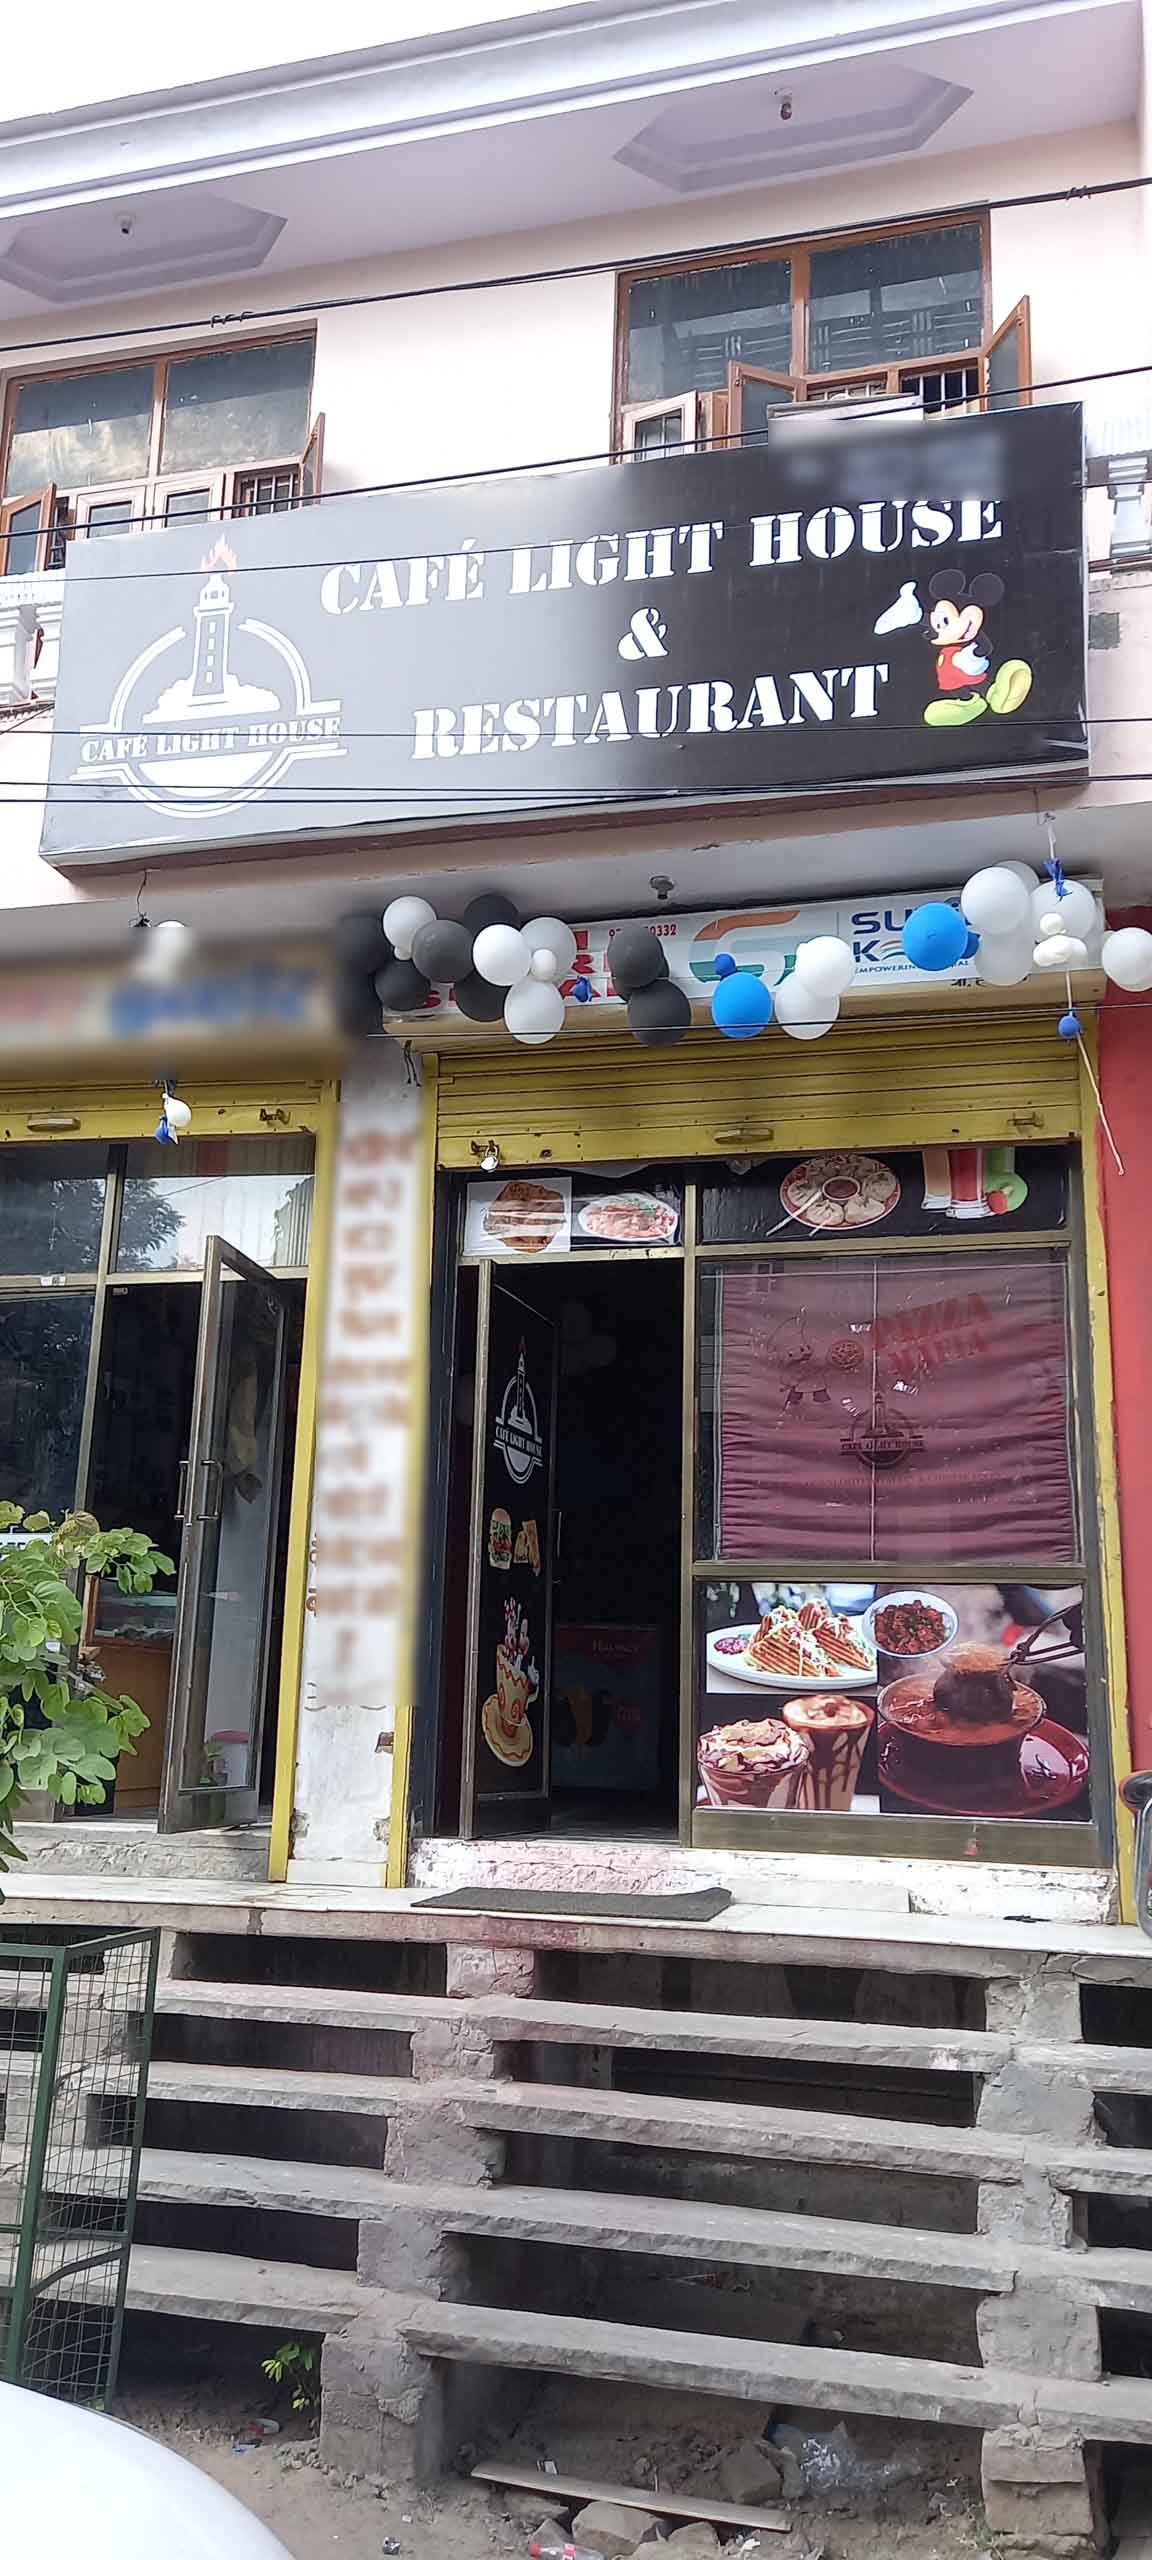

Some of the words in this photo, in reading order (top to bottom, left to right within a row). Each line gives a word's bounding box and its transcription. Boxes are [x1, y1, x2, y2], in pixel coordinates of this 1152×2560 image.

[320, 537, 487, 615] CAFÉ
[509, 521, 724, 595] LIGHT
[748, 499, 1003, 568] HOUSE
[617, 607, 669, 661] &
[156, 726, 240, 754] LIGHT
[248, 717, 341, 747] HOUSE
[411, 664, 889, 760] RESTAURANT
